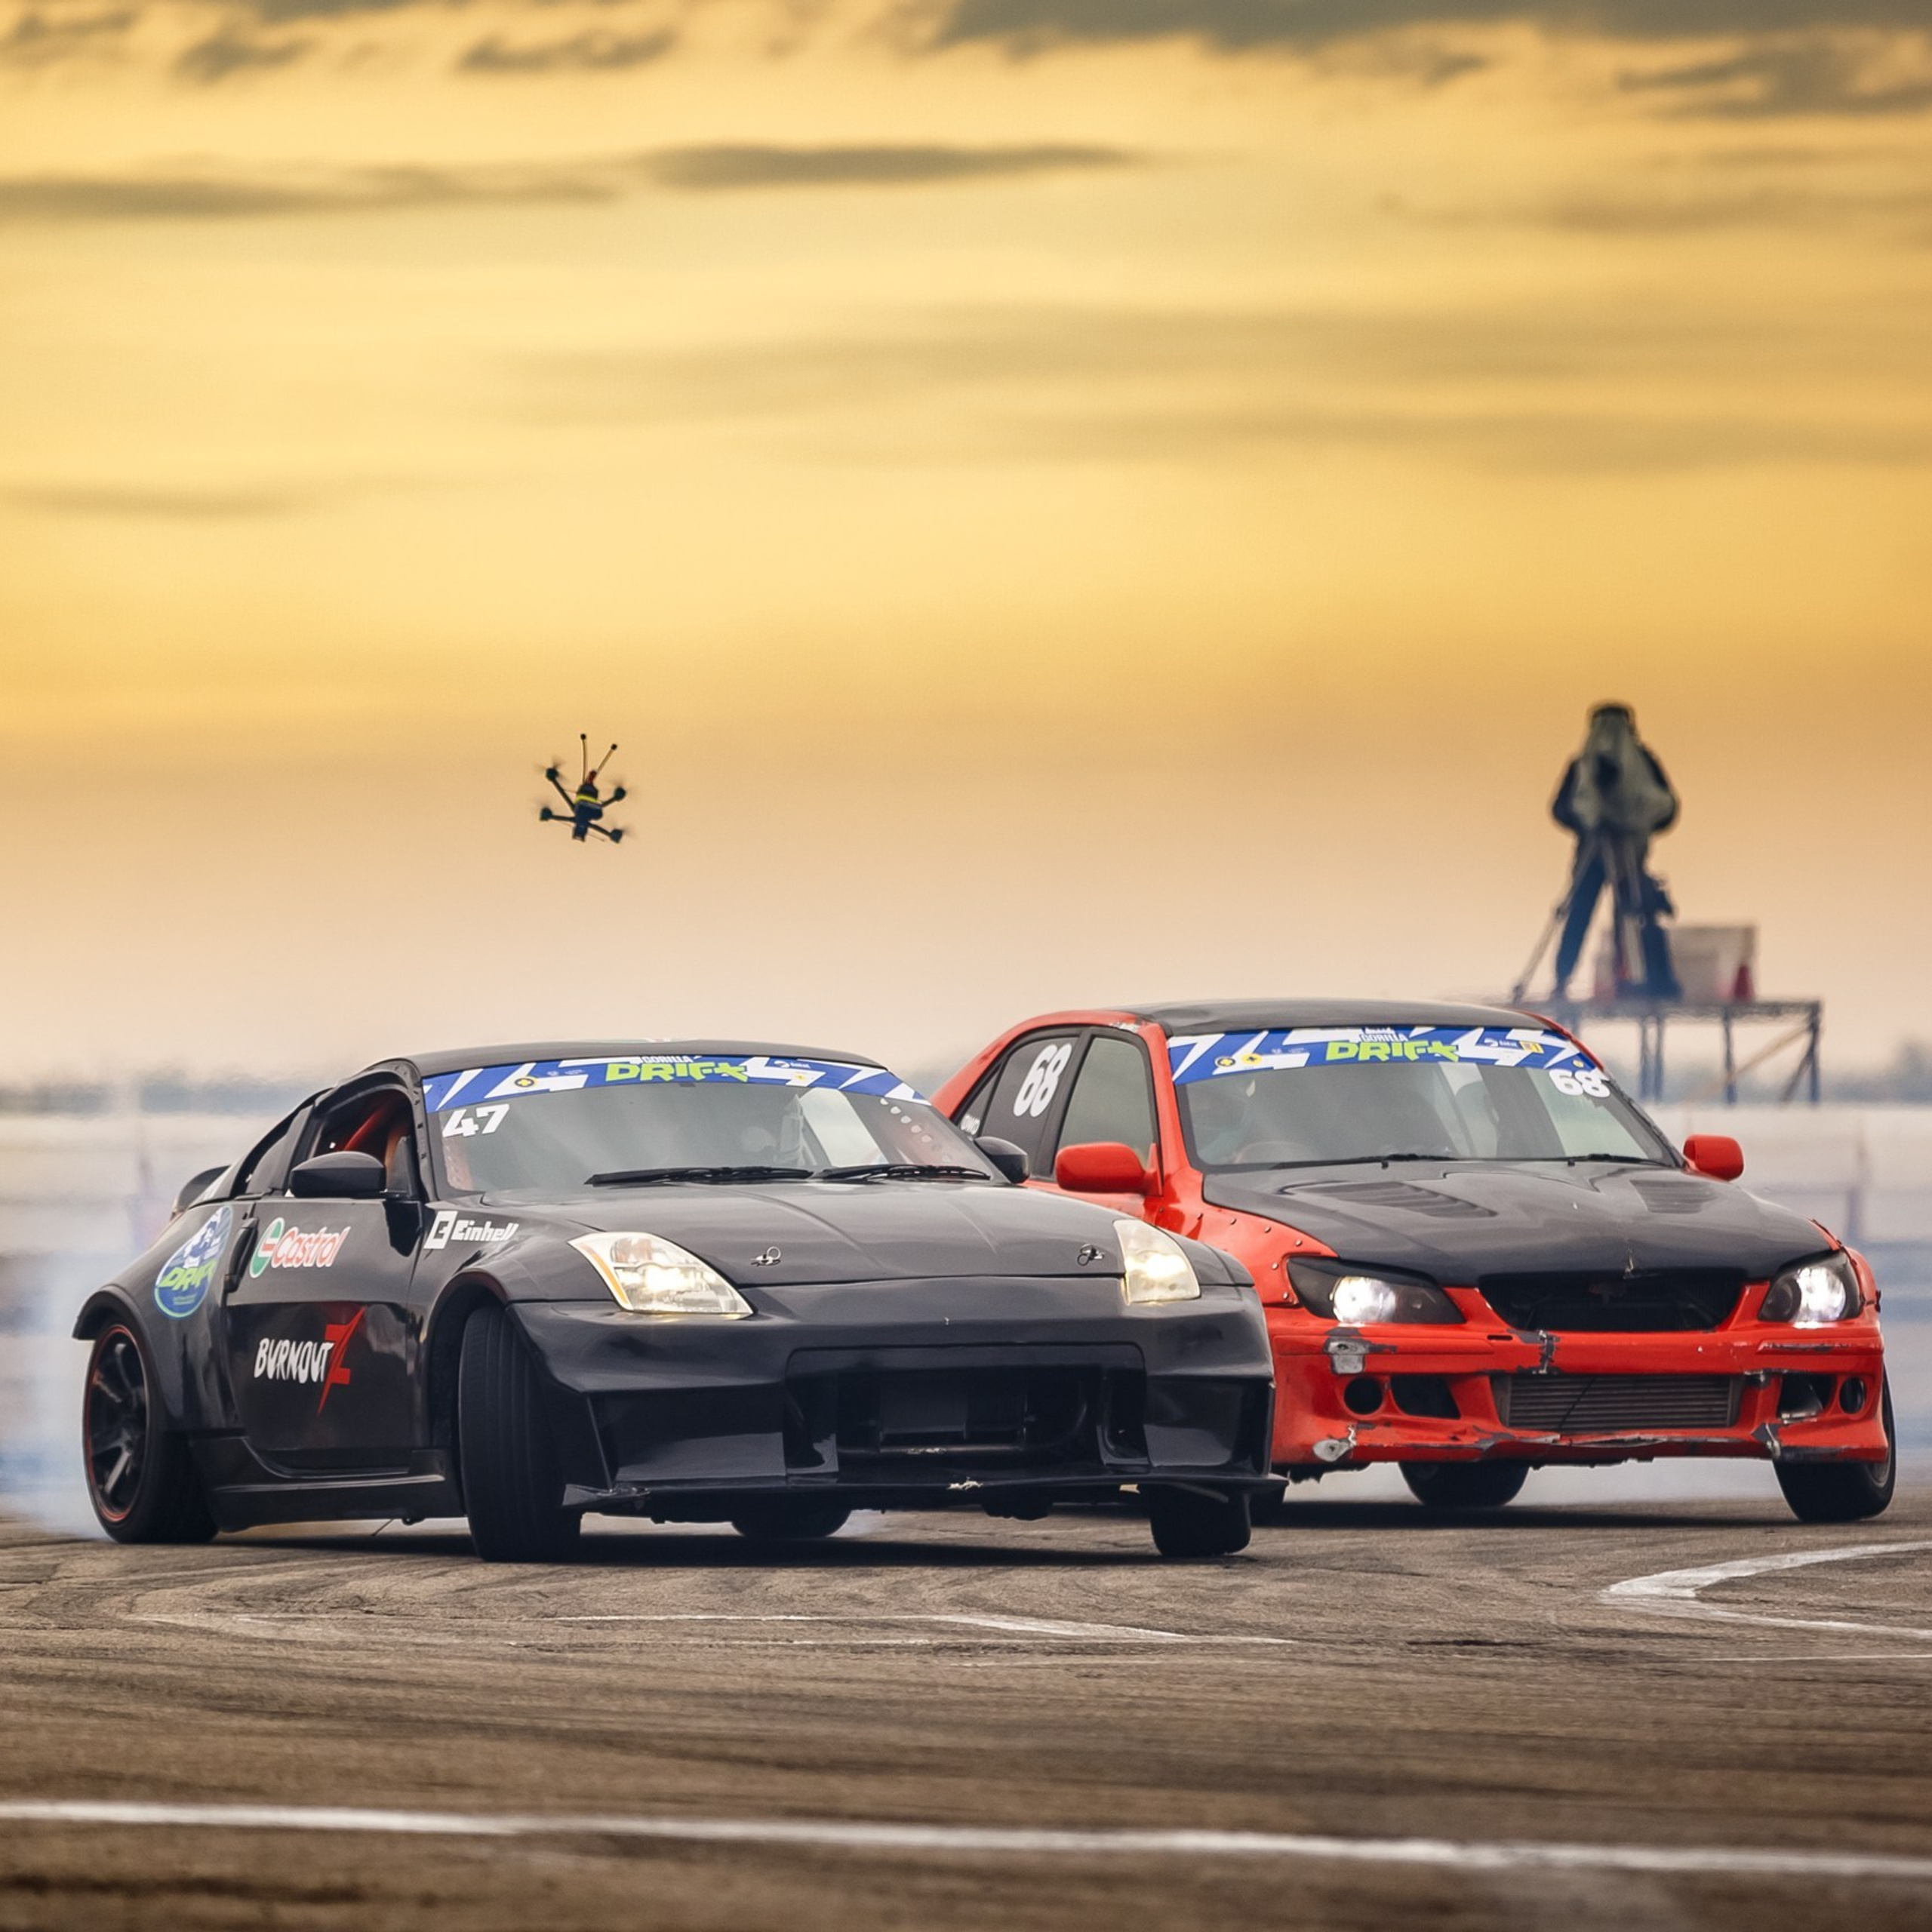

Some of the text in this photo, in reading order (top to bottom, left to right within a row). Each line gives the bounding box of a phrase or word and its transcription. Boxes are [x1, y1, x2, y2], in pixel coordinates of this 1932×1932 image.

[1360, 1033, 1409, 1042] GORILLA
[642, 1056, 694, 1064] GORILLA
[1325, 1040, 1460, 1062] DRIFT
[605, 1061, 749, 1082] DRIFT
[1014, 1043, 1072, 1118] 68
[1549, 1069, 1611, 1098] 68
[442, 1103, 510, 1138] 47
[451, 1220, 519, 1241] Einhell
[272, 1226, 351, 1268] Castrol
[254, 1337, 335, 1384] BURNOUT
